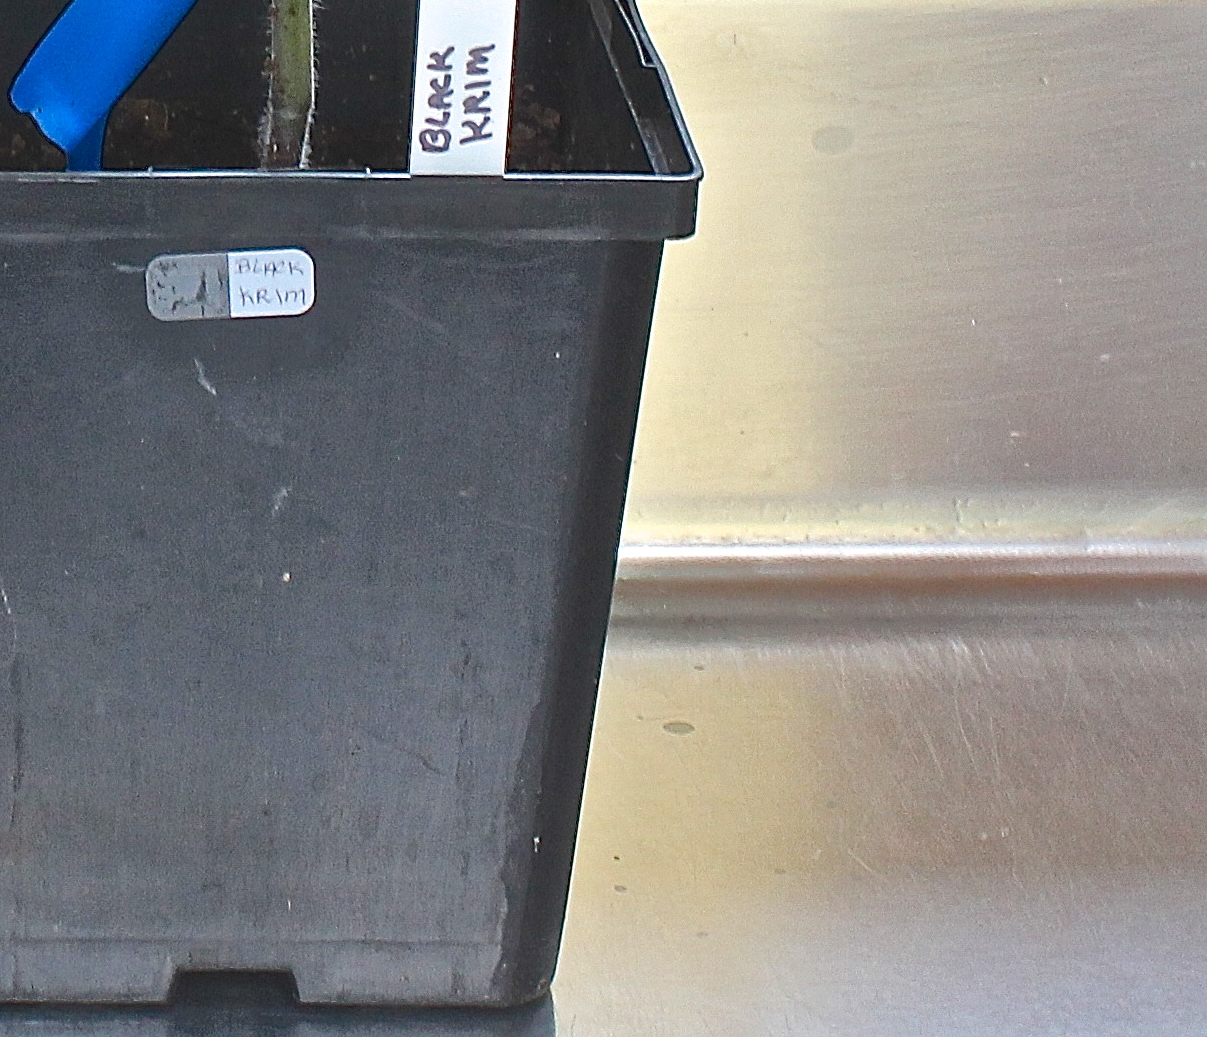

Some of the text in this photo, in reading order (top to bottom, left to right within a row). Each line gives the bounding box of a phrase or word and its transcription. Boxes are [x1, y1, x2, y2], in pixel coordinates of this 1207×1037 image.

[418, 46, 455, 153] BLACK
[459, 43, 496, 145] KRIM
[239, 286, 306, 307] KRIM
